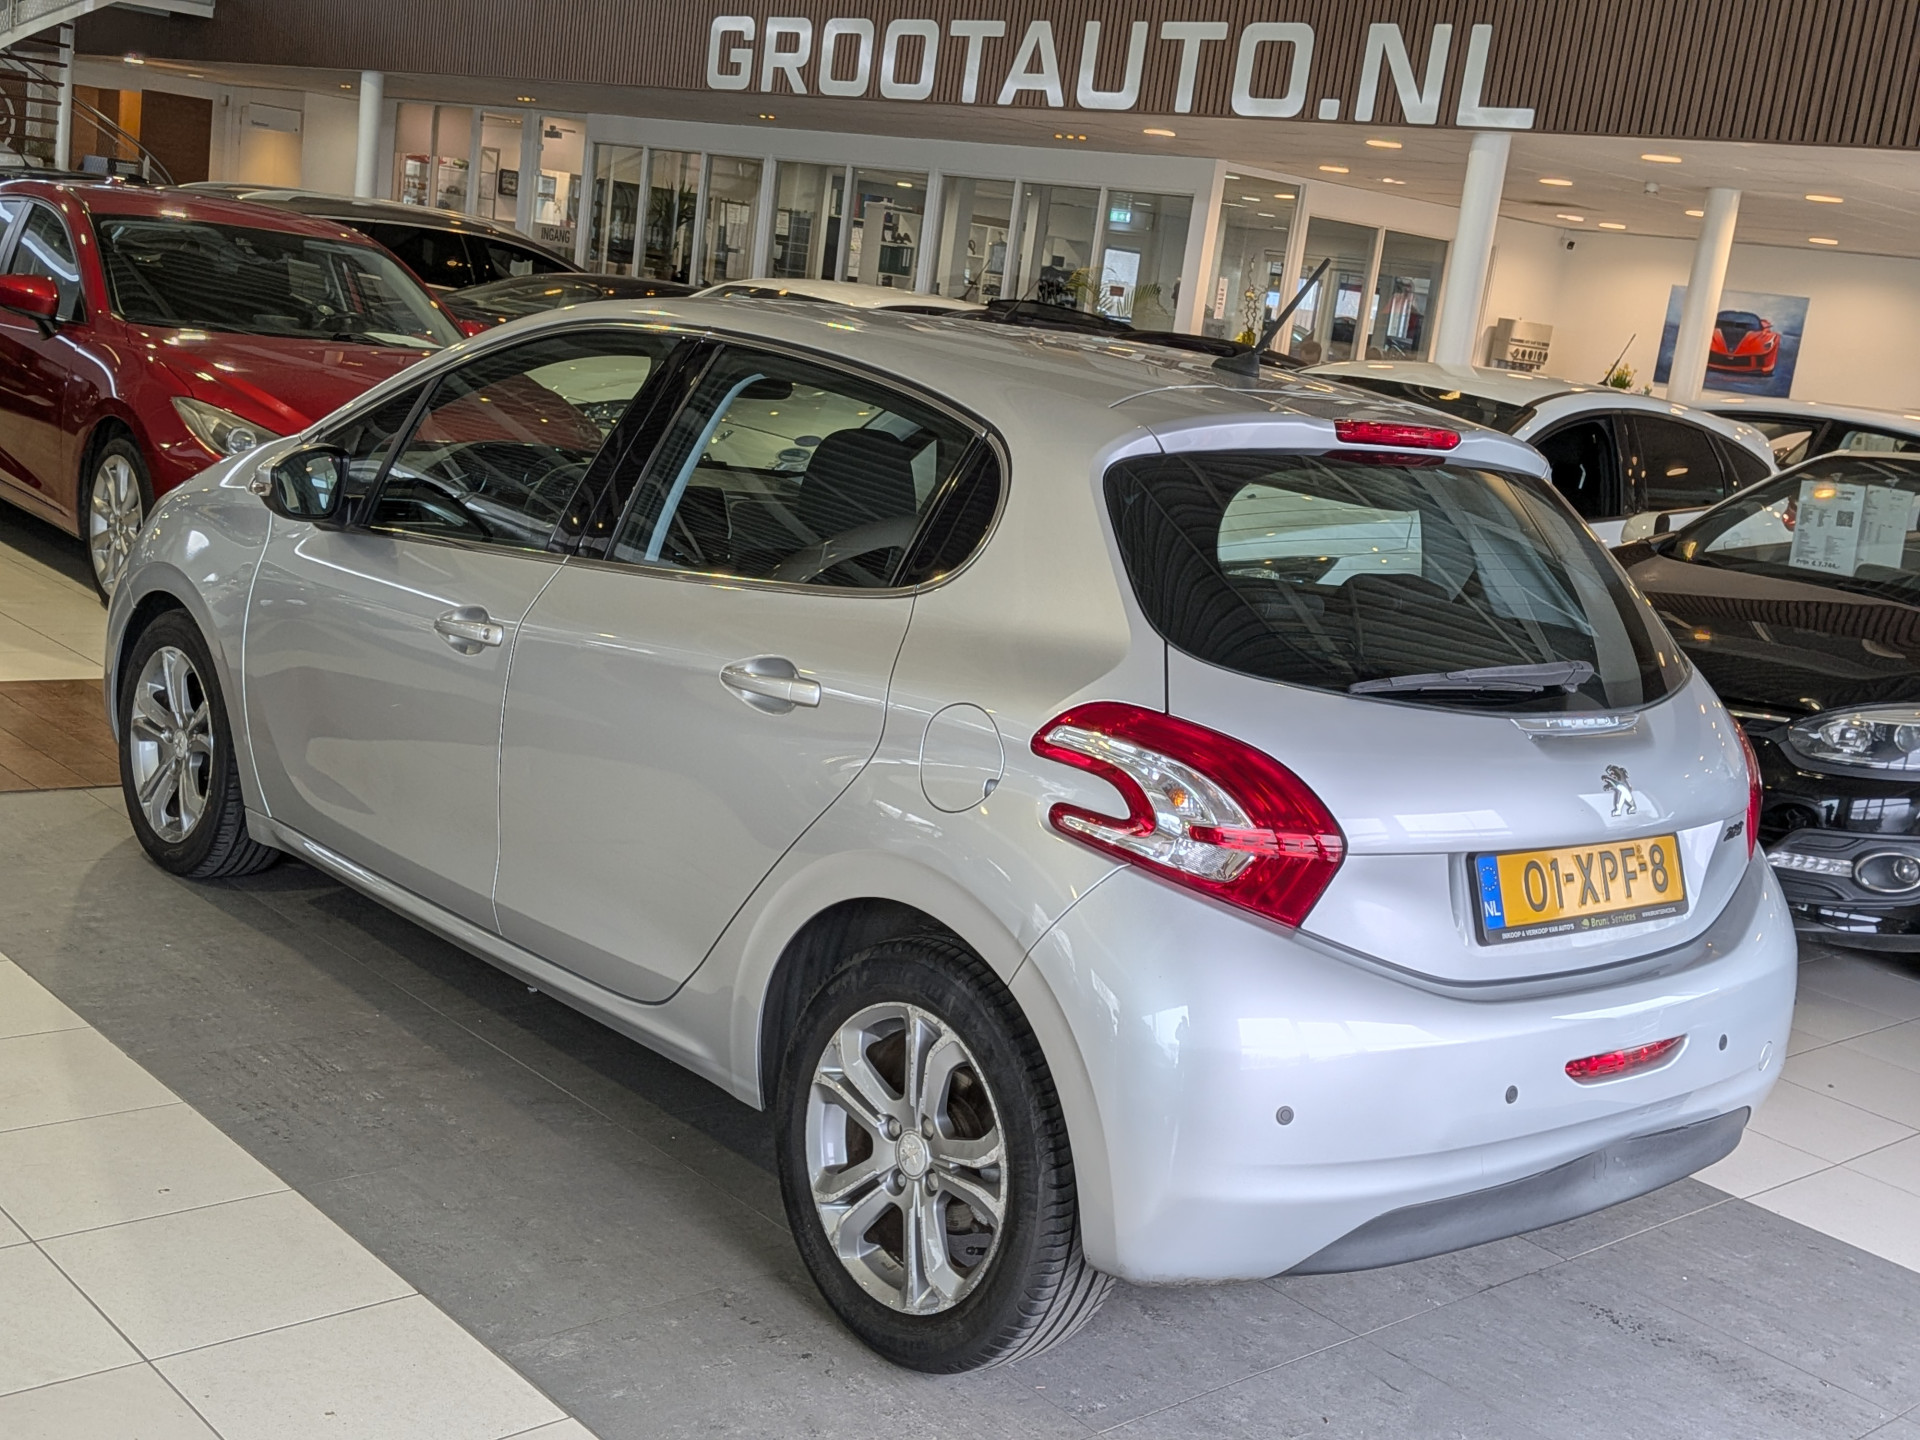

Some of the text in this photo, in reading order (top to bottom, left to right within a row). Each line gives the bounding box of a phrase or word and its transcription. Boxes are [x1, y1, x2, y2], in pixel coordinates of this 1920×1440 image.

[708, 15, 1536, 130] GROOTAUTO.NL
[541, 227, 571, 244] INGANG
[1523, 843, 1669, 913] 01-XPF-8
[1484, 900, 1502, 918] NL
[1610, 912, 1637, 925] Services
[1501, 931, 1522, 940] INKOOP
[1525, 927, 1549, 937] VERKOOP
[1548, 924, 1559, 933] VAN
[1558, 923, 1575, 932] AUTO'S
